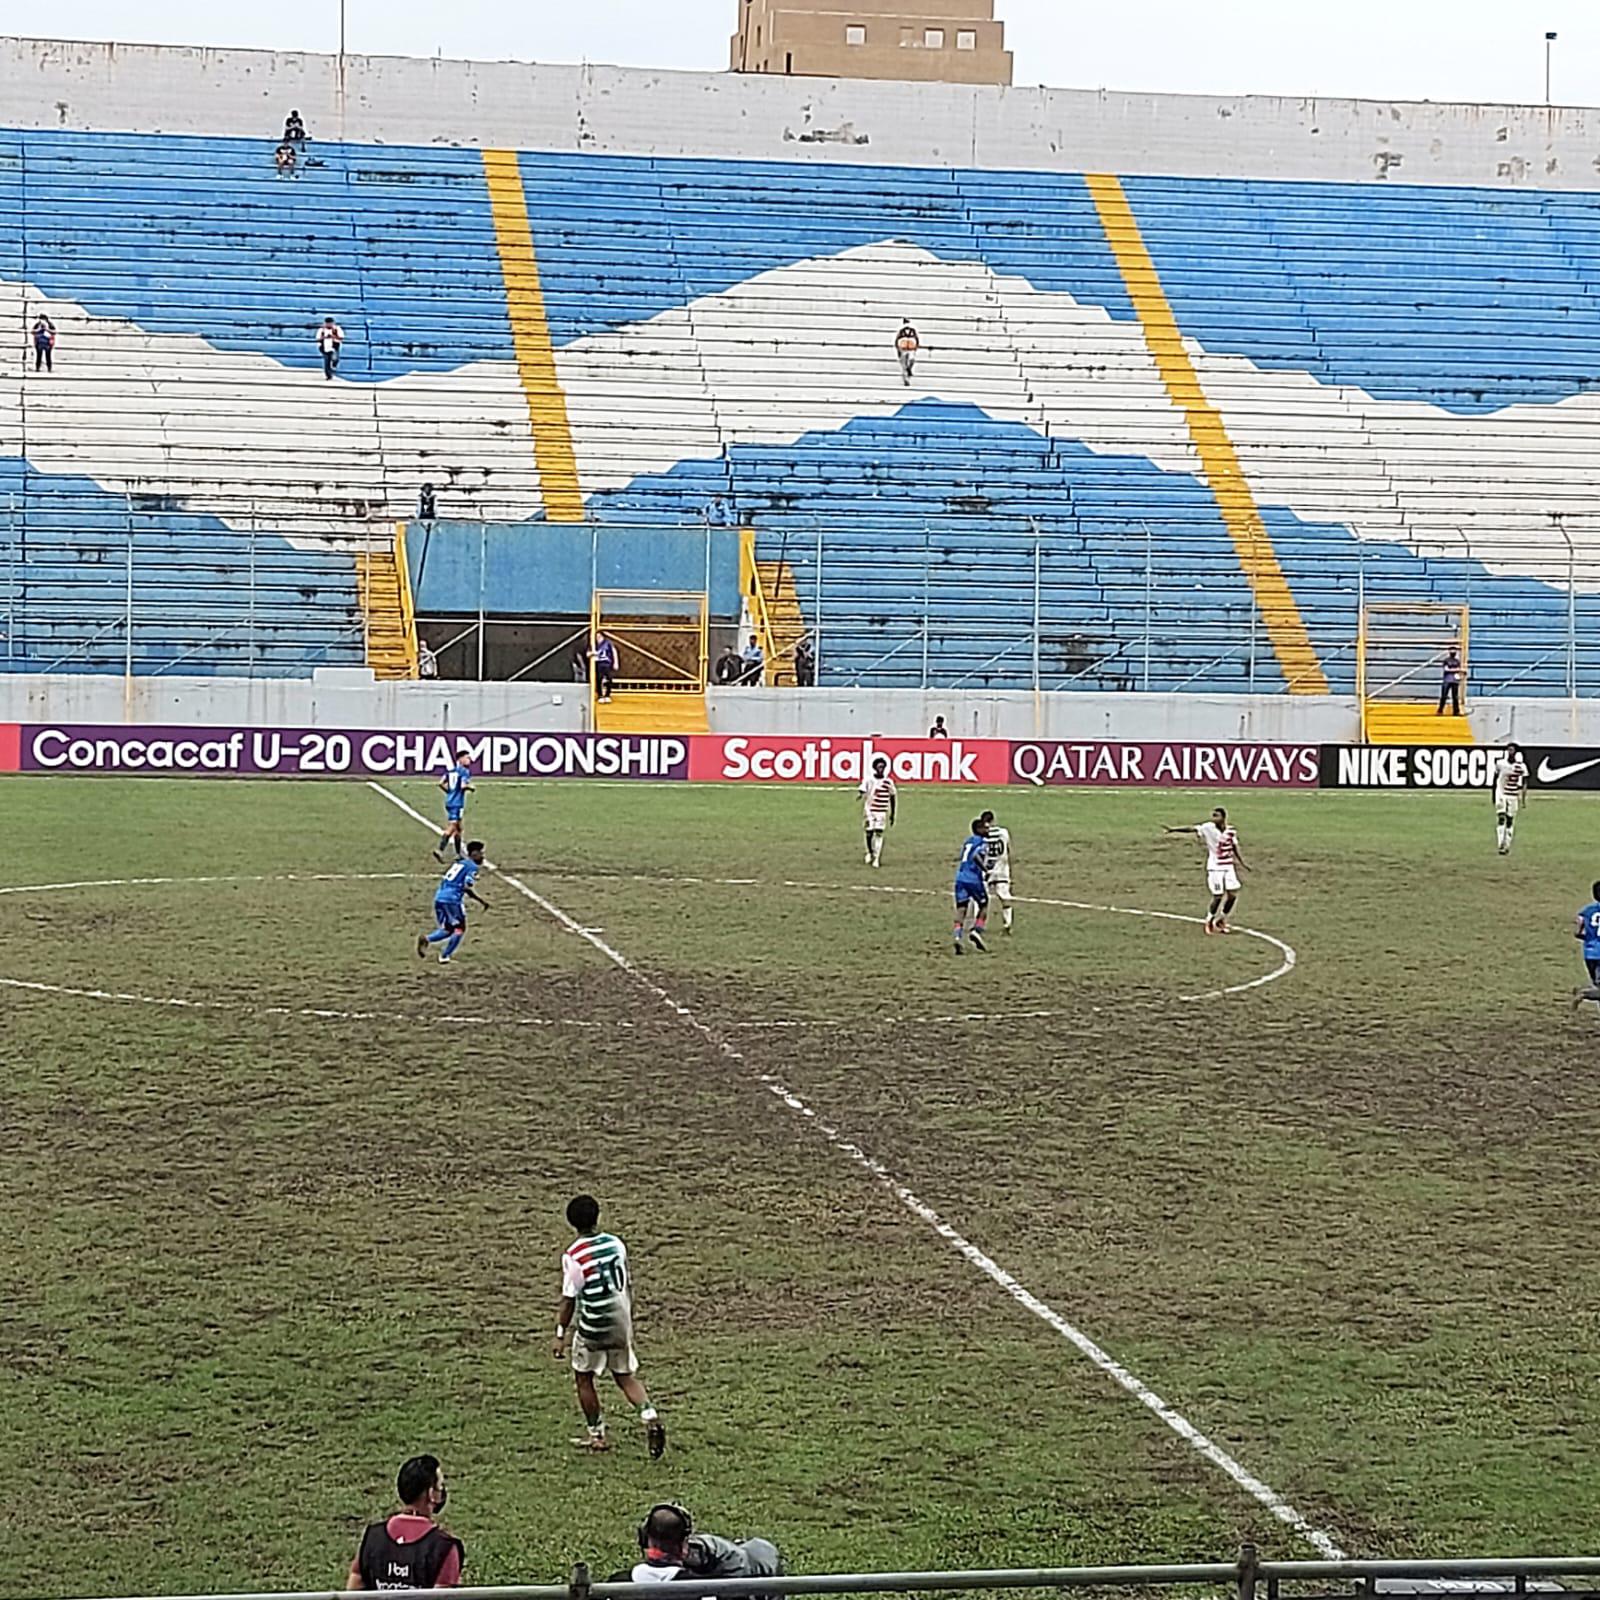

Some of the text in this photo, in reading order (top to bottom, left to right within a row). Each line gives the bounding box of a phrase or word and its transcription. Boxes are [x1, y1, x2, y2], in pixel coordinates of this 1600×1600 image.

[32, 729, 686, 775] Concacaf U-20 CHAMPIONSHIP
[722, 738, 979, 783] Scotiabank
[1013, 744, 1320, 786] QATAR AIRWAYS
[1338, 748, 1408, 785] NIKE
